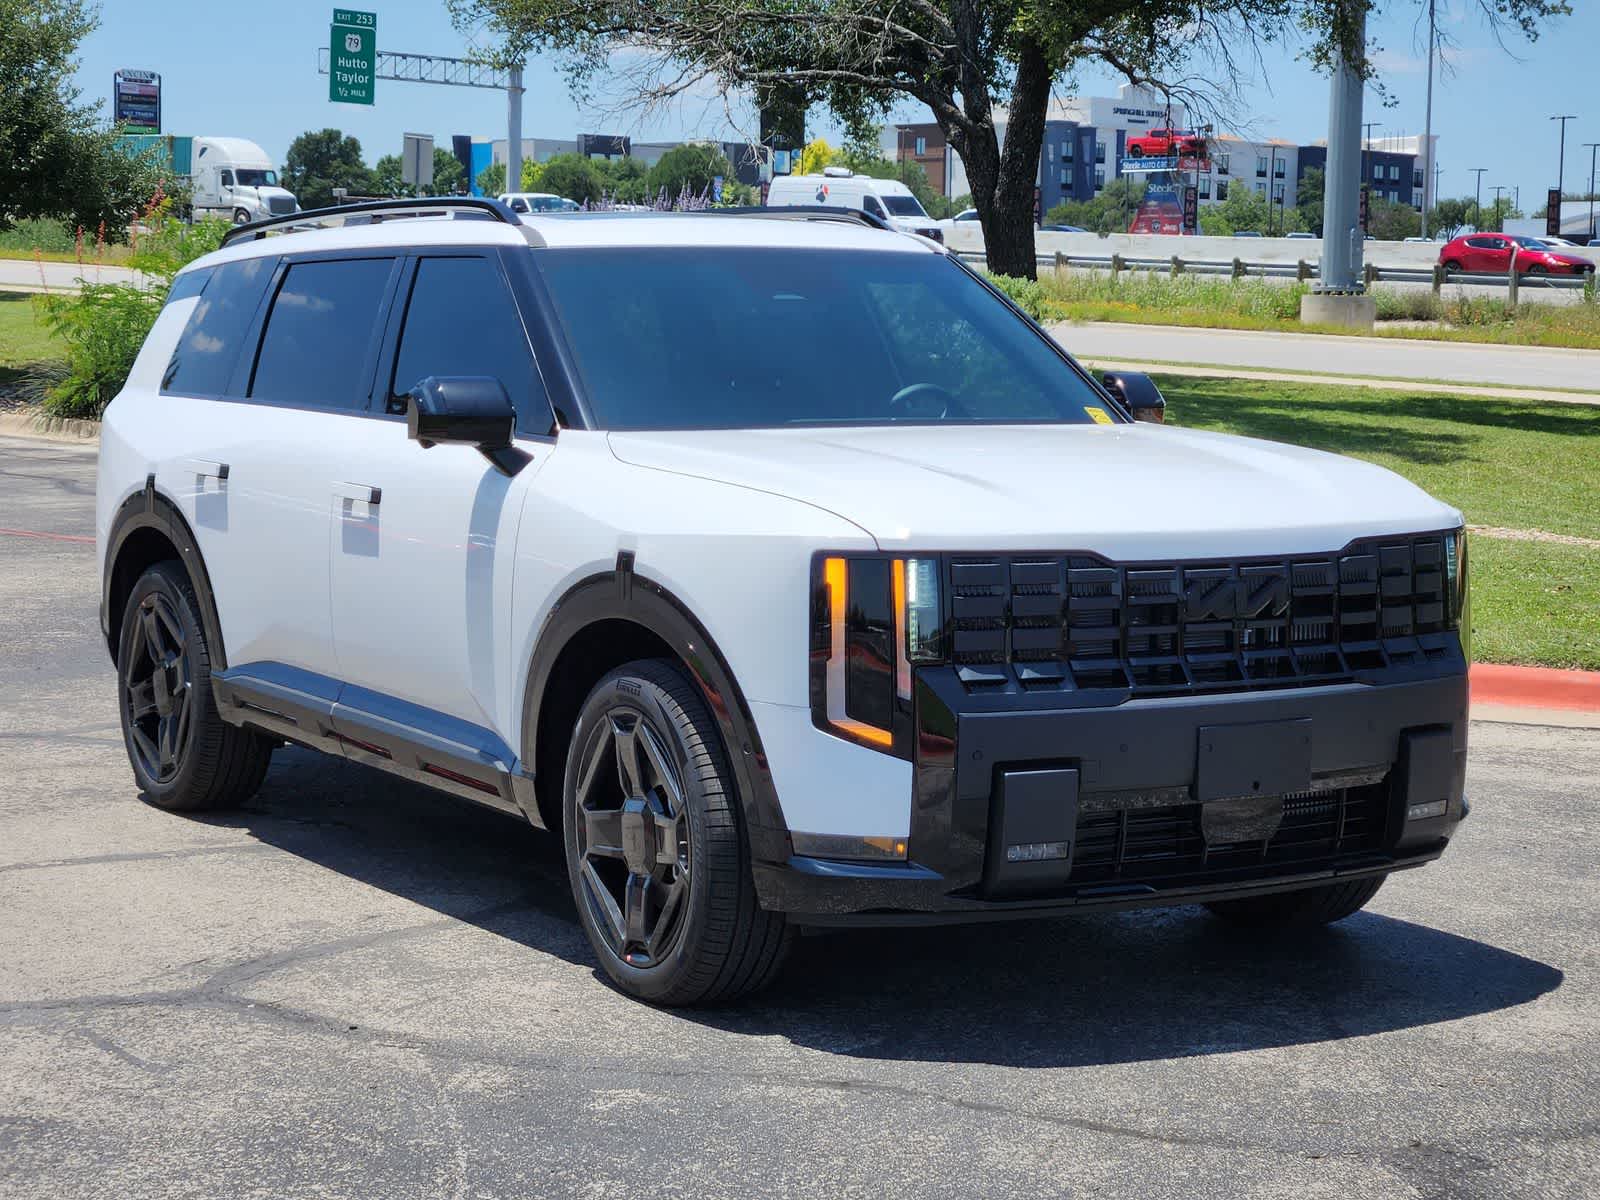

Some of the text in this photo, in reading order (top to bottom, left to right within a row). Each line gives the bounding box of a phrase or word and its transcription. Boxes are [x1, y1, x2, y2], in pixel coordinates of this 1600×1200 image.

[337, 13, 373, 25] EXIT 253
[347, 37, 360, 48] 79
[337, 57, 368, 69] Hutto
[335, 71, 369, 85] Taylor
[350, 89, 366, 97] MILE
[1185, 188, 1196, 226] GMC
